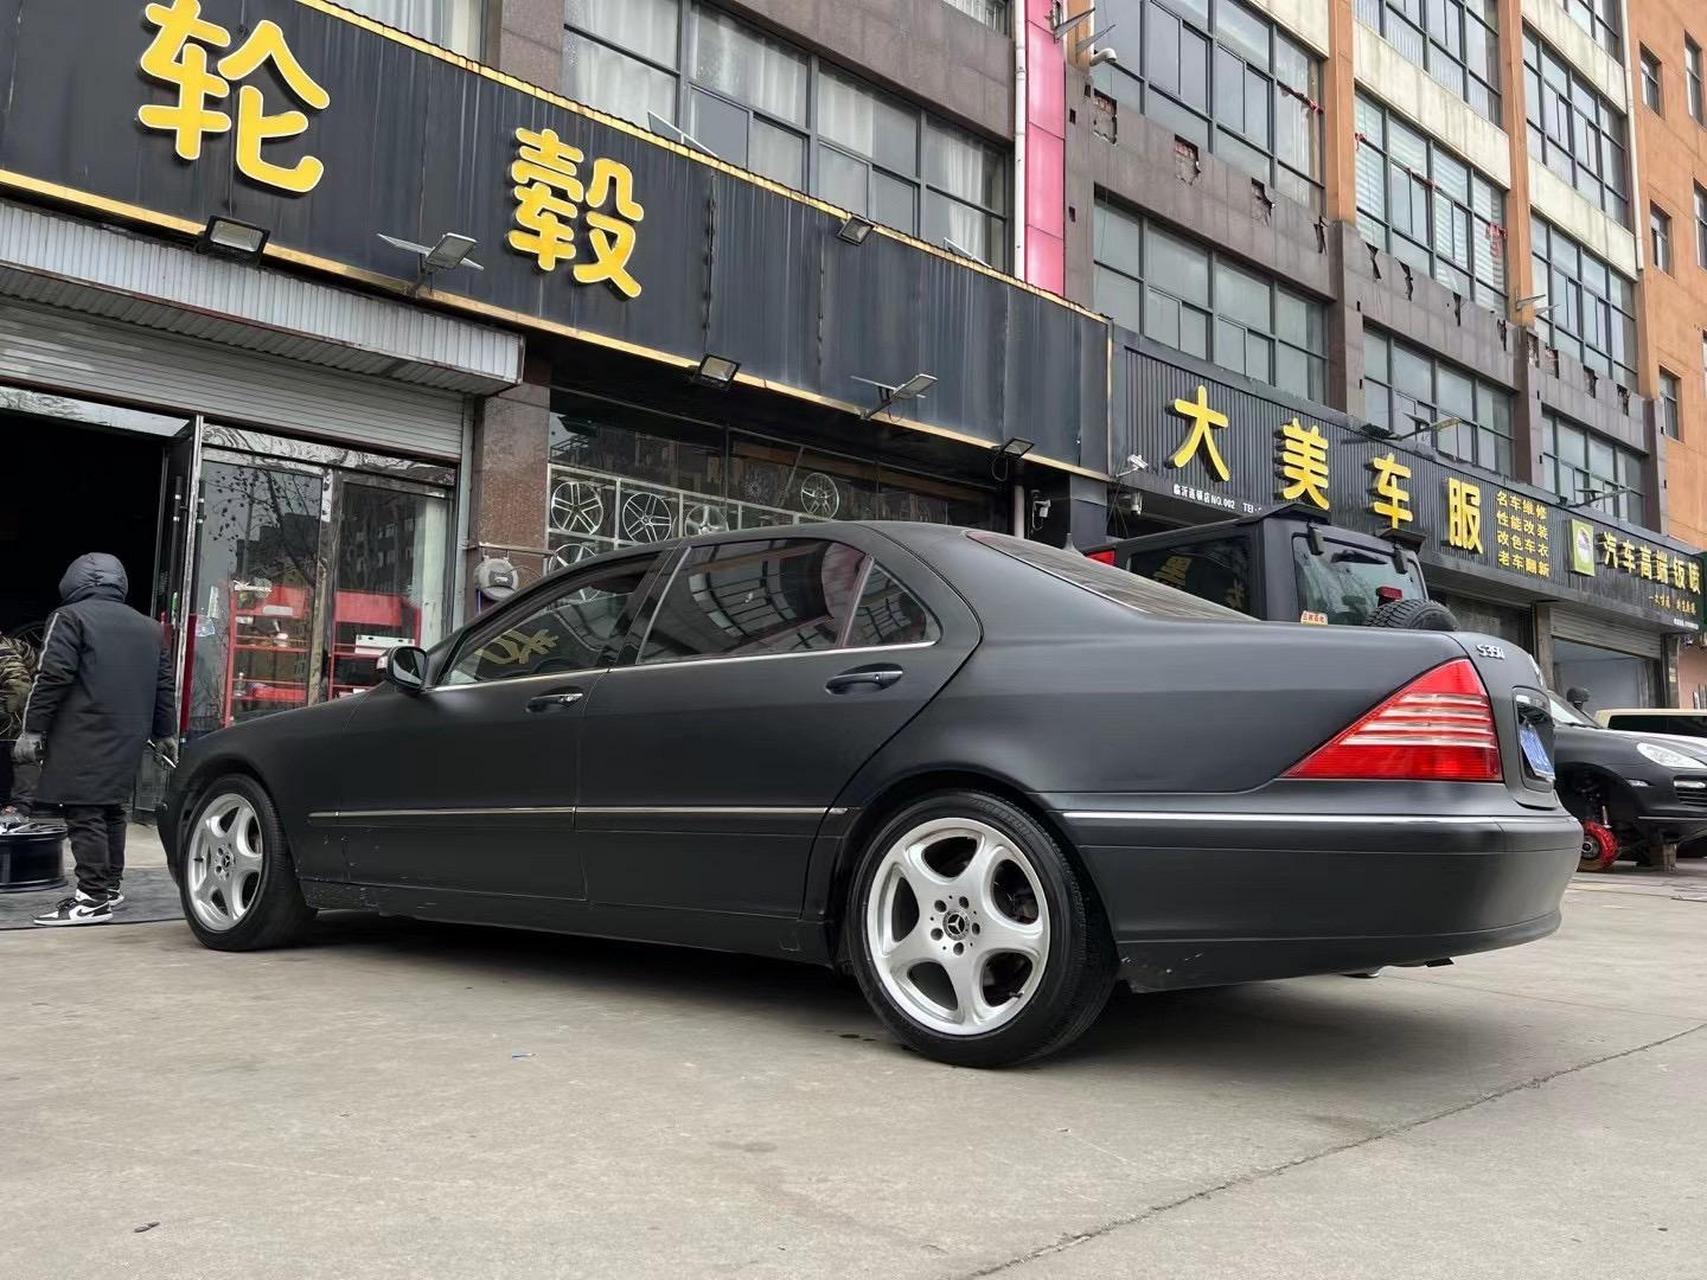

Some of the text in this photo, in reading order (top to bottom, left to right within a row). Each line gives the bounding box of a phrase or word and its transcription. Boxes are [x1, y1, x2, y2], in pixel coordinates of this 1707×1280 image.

[138, 0, 645, 298] 轮毂
[1171, 385, 1483, 554] 大美车服
